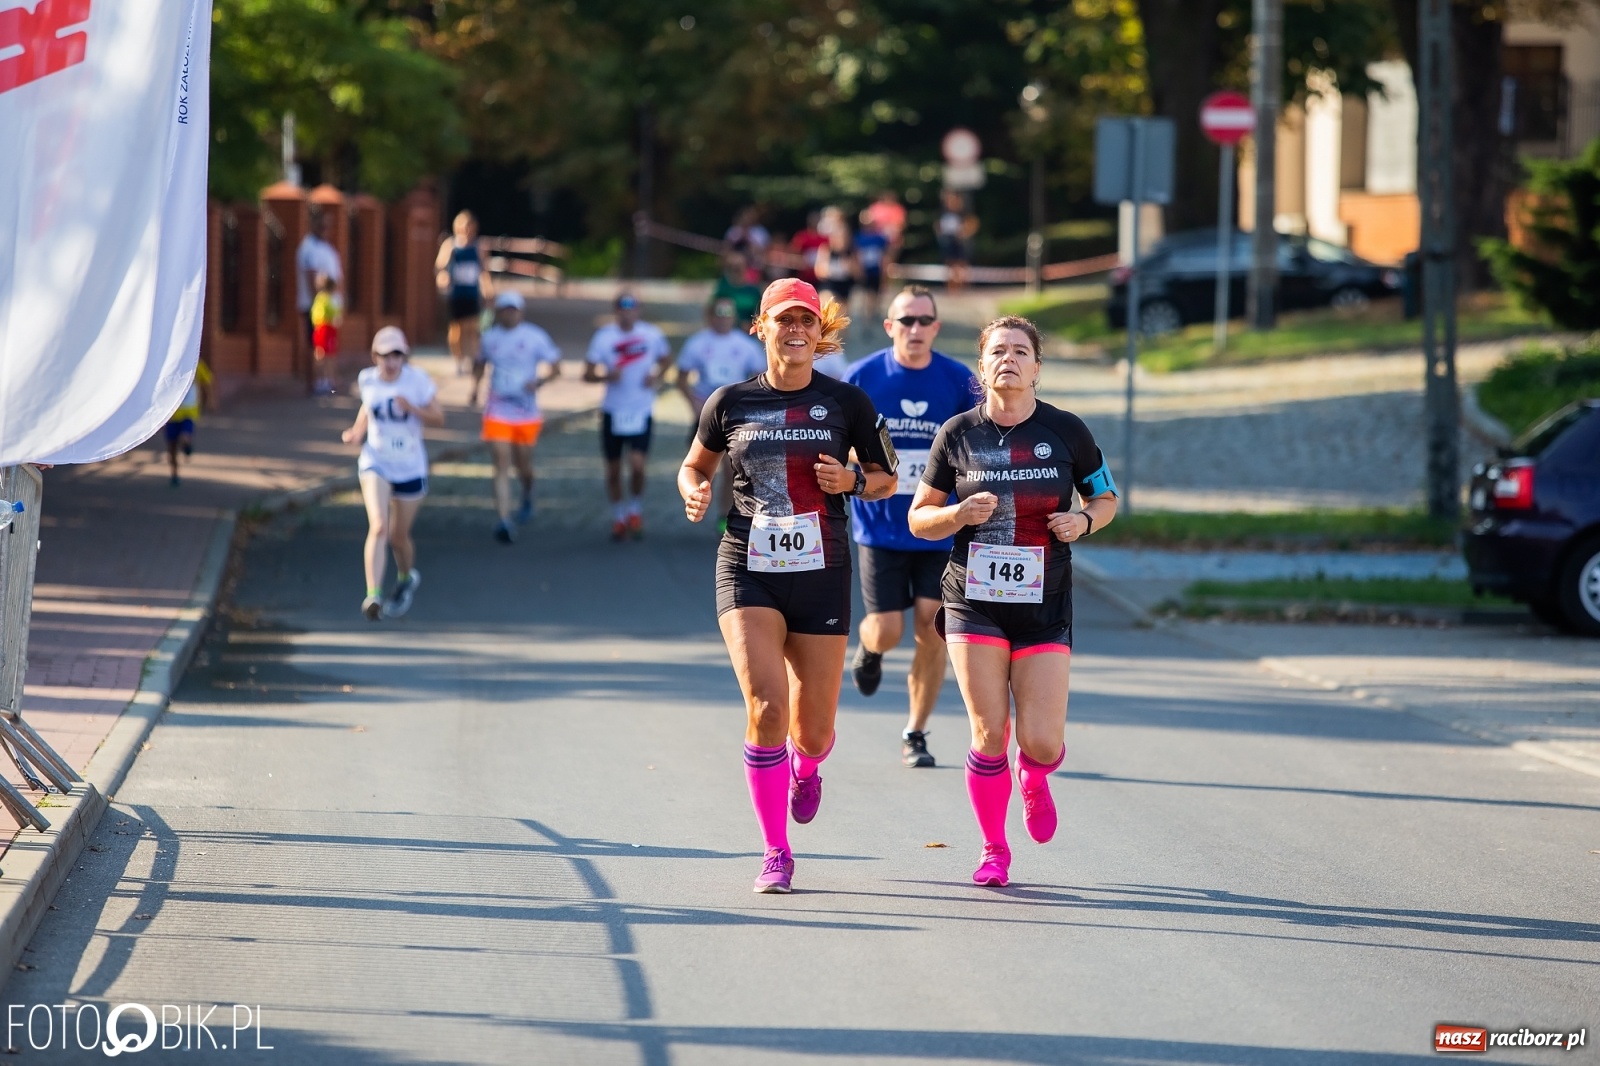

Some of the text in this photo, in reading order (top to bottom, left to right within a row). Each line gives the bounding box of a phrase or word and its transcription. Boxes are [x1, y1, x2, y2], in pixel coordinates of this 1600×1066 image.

[177, 95, 188, 125] ROK
[738, 428, 832, 441] RUNMAGEDDON
[966, 467, 1059, 482] RUNMAGEDDON
[768, 532, 805, 552] 140
[988, 561, 1025, 582] 148
